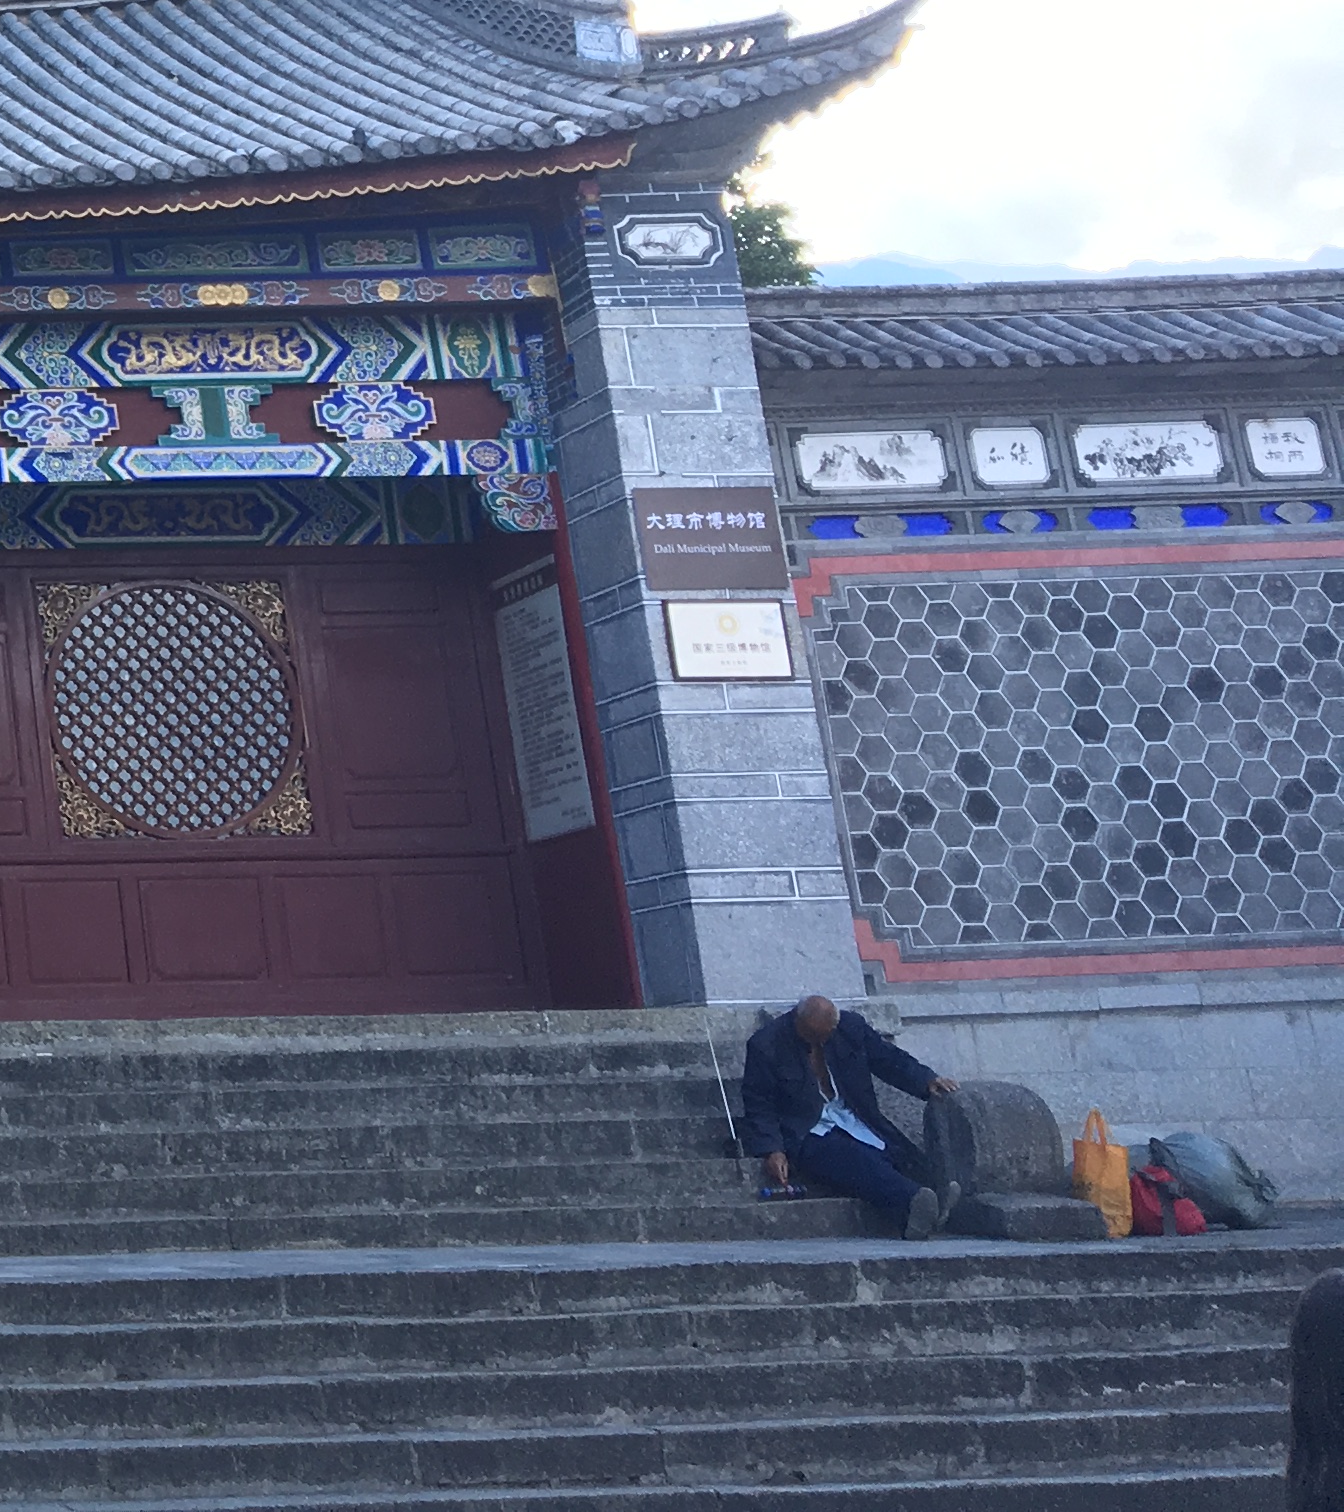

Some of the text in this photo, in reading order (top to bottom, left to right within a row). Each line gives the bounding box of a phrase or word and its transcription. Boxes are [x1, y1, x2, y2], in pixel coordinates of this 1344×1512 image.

[646, 511, 766, 530] 大理市博物馆
[654, 542, 772, 555] Dali Municipal Museum
